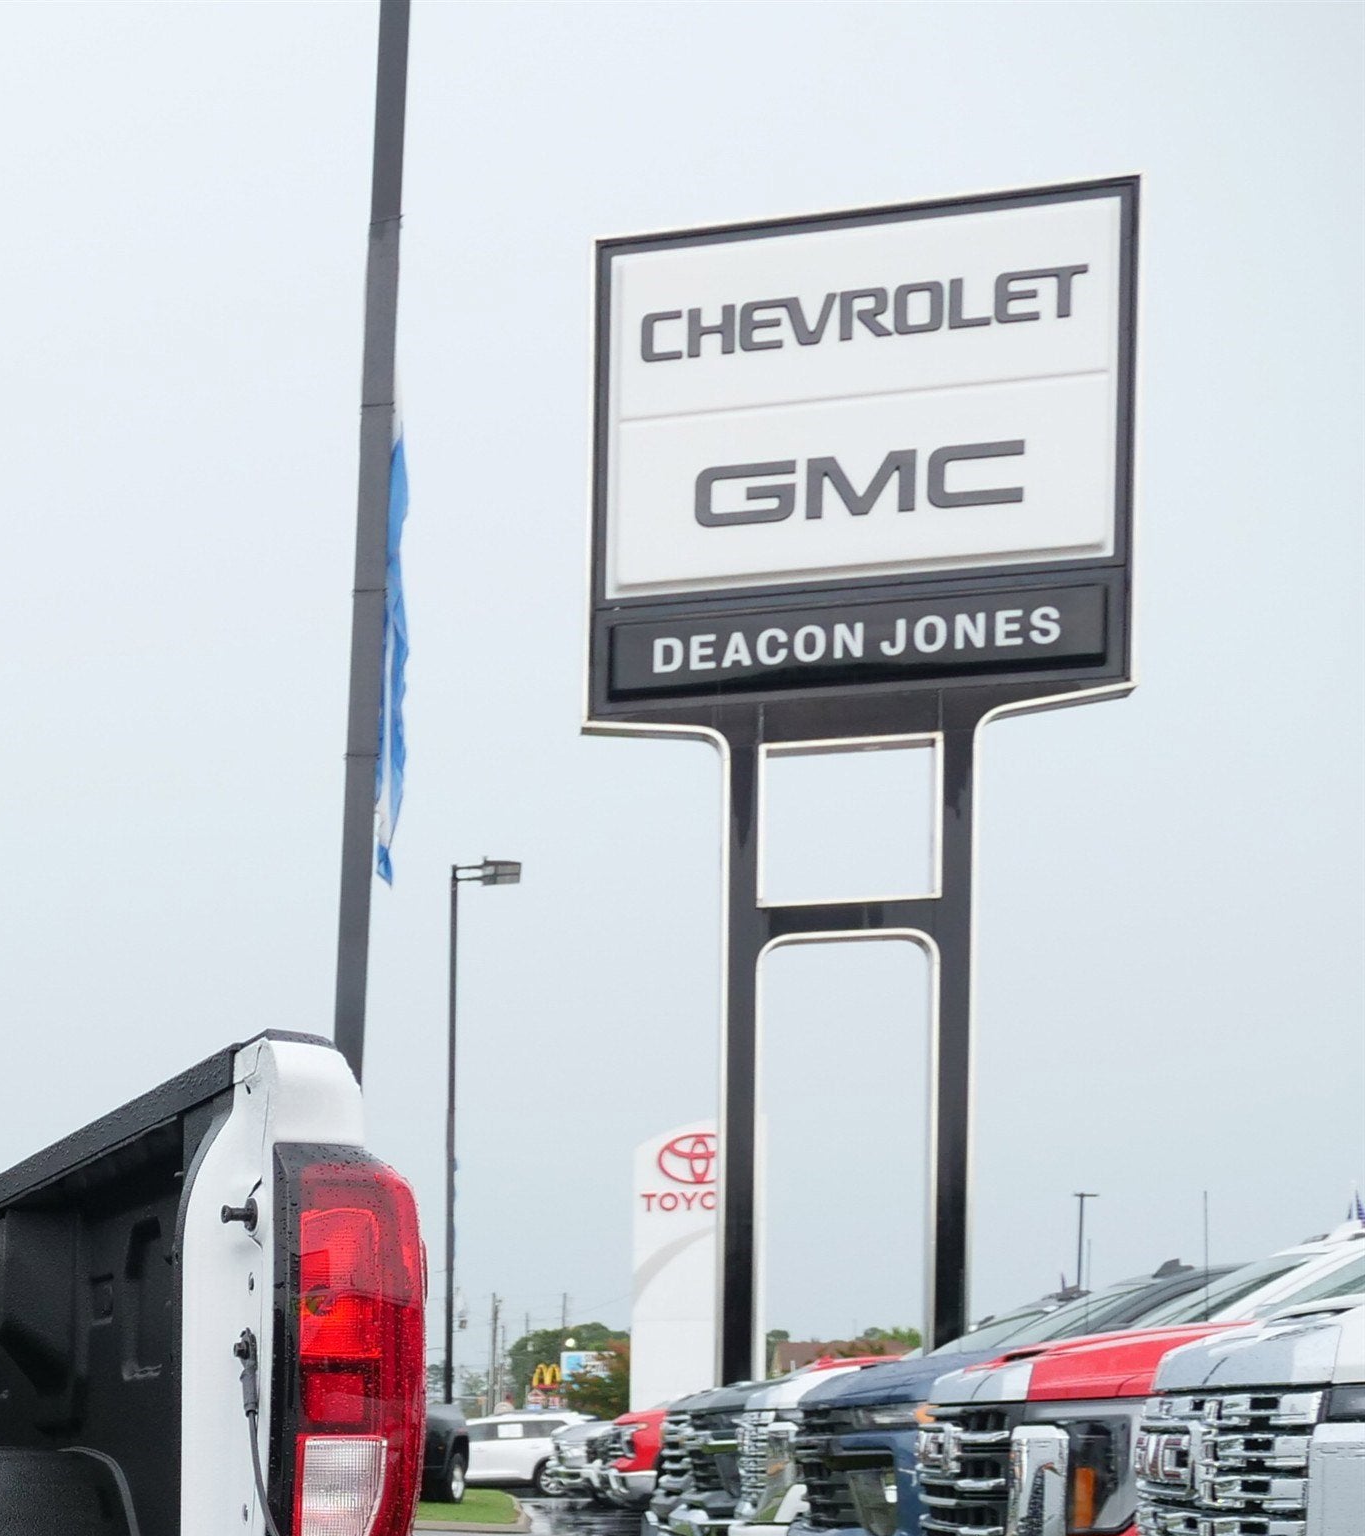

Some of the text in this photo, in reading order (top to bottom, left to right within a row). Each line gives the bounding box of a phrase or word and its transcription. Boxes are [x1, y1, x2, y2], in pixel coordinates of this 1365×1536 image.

[640, 263, 1089, 363] CHEVROLET
[694, 438, 1026, 528] GMC
[652, 604, 1063, 675] DEACON JONES
